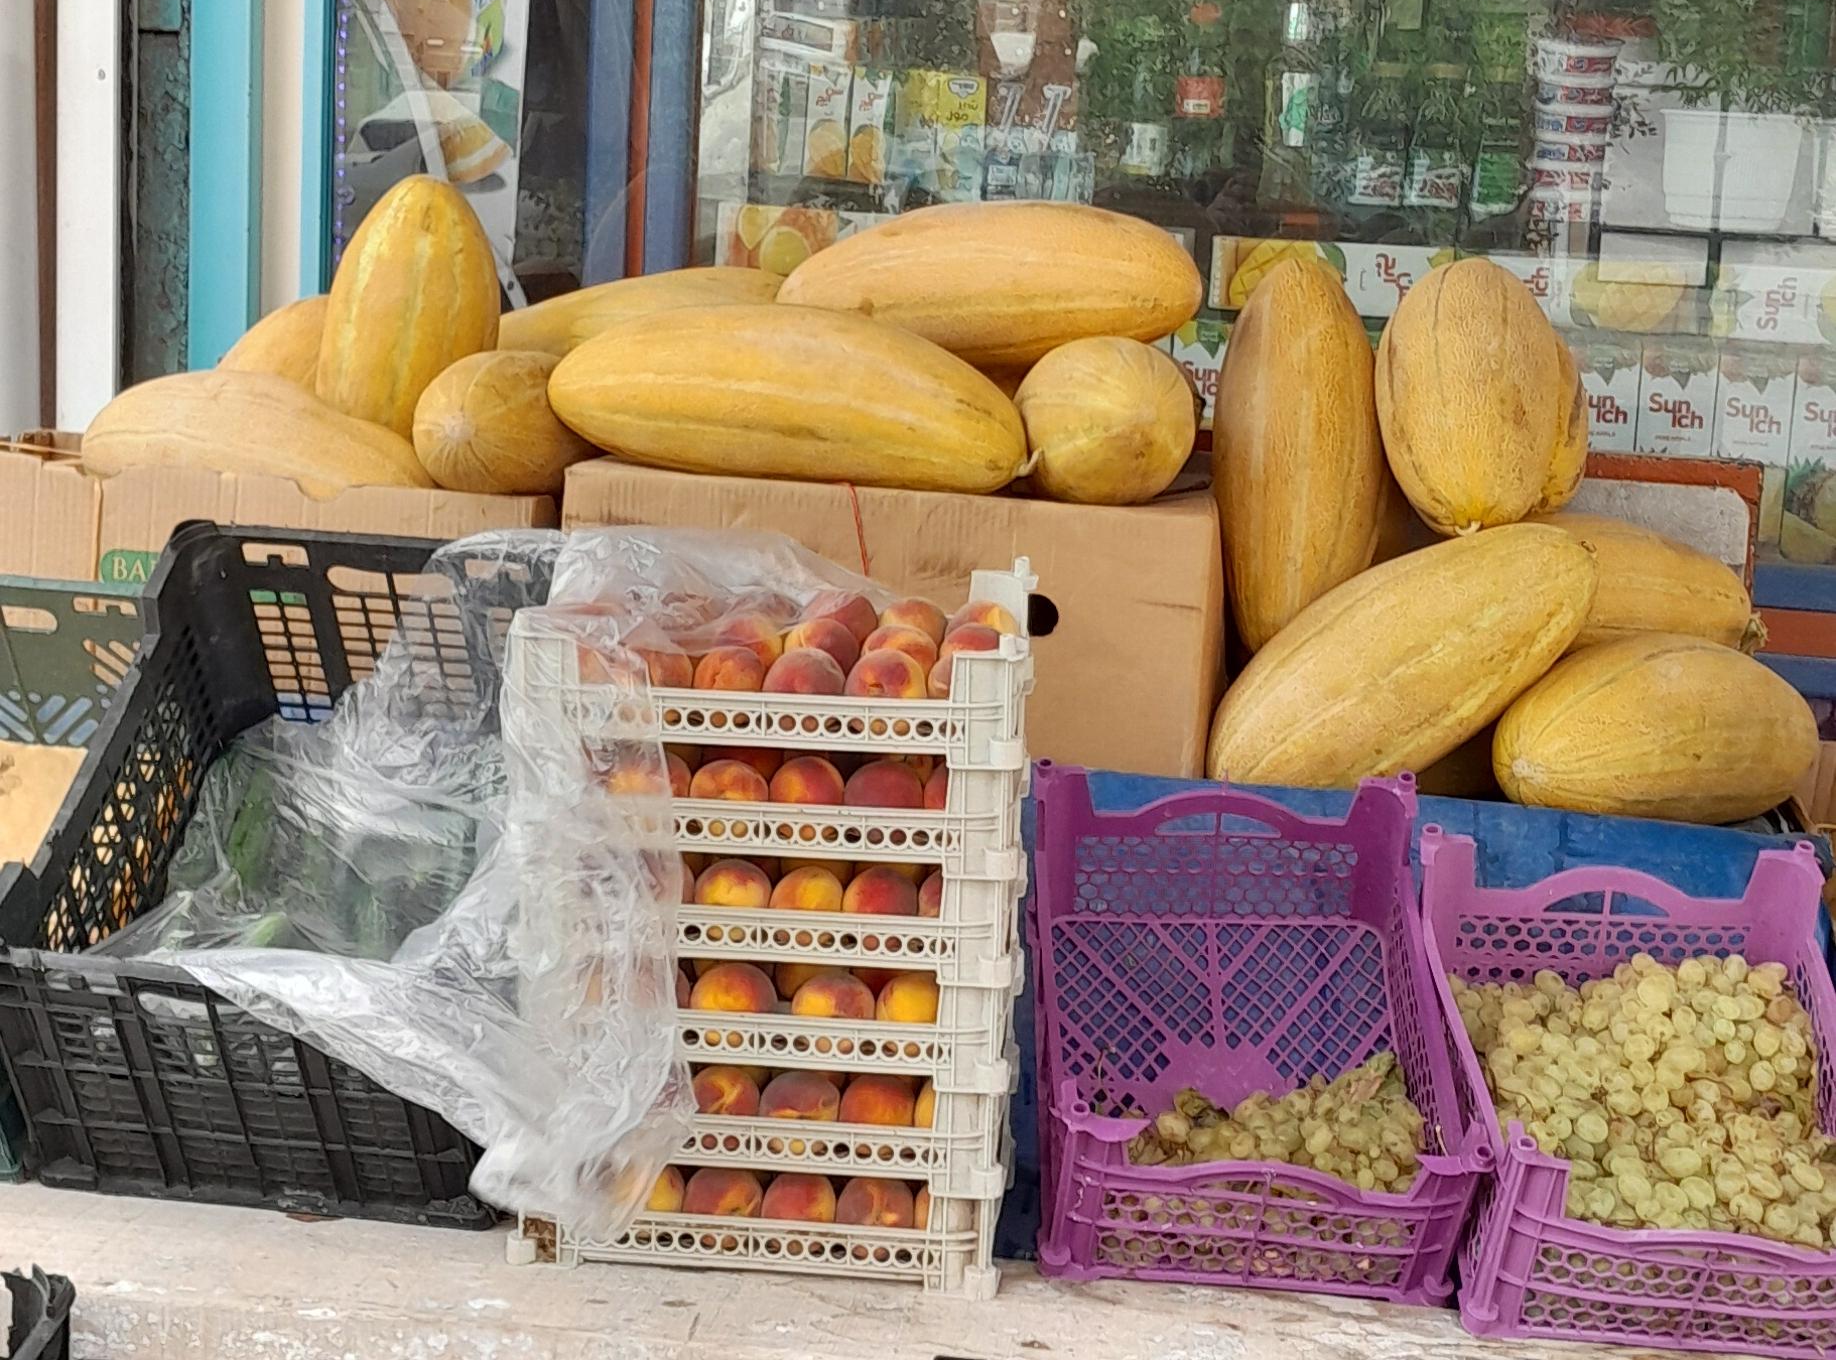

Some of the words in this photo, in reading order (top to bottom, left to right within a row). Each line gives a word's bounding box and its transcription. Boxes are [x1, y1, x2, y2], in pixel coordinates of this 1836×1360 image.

[1778, 276, 1798, 309] Ich
[1756, 290, 1781, 331] Sun
[1588, 394, 1616, 410] un
[1648, 392, 1691, 414] Sun
[1725, 397, 1769, 420] Sun
[1595, 404, 1629, 425] Ich
[1671, 409, 1704, 430] Ich
[1749, 415, 1782, 435] Ich
[112, 556, 157, 583] BA
